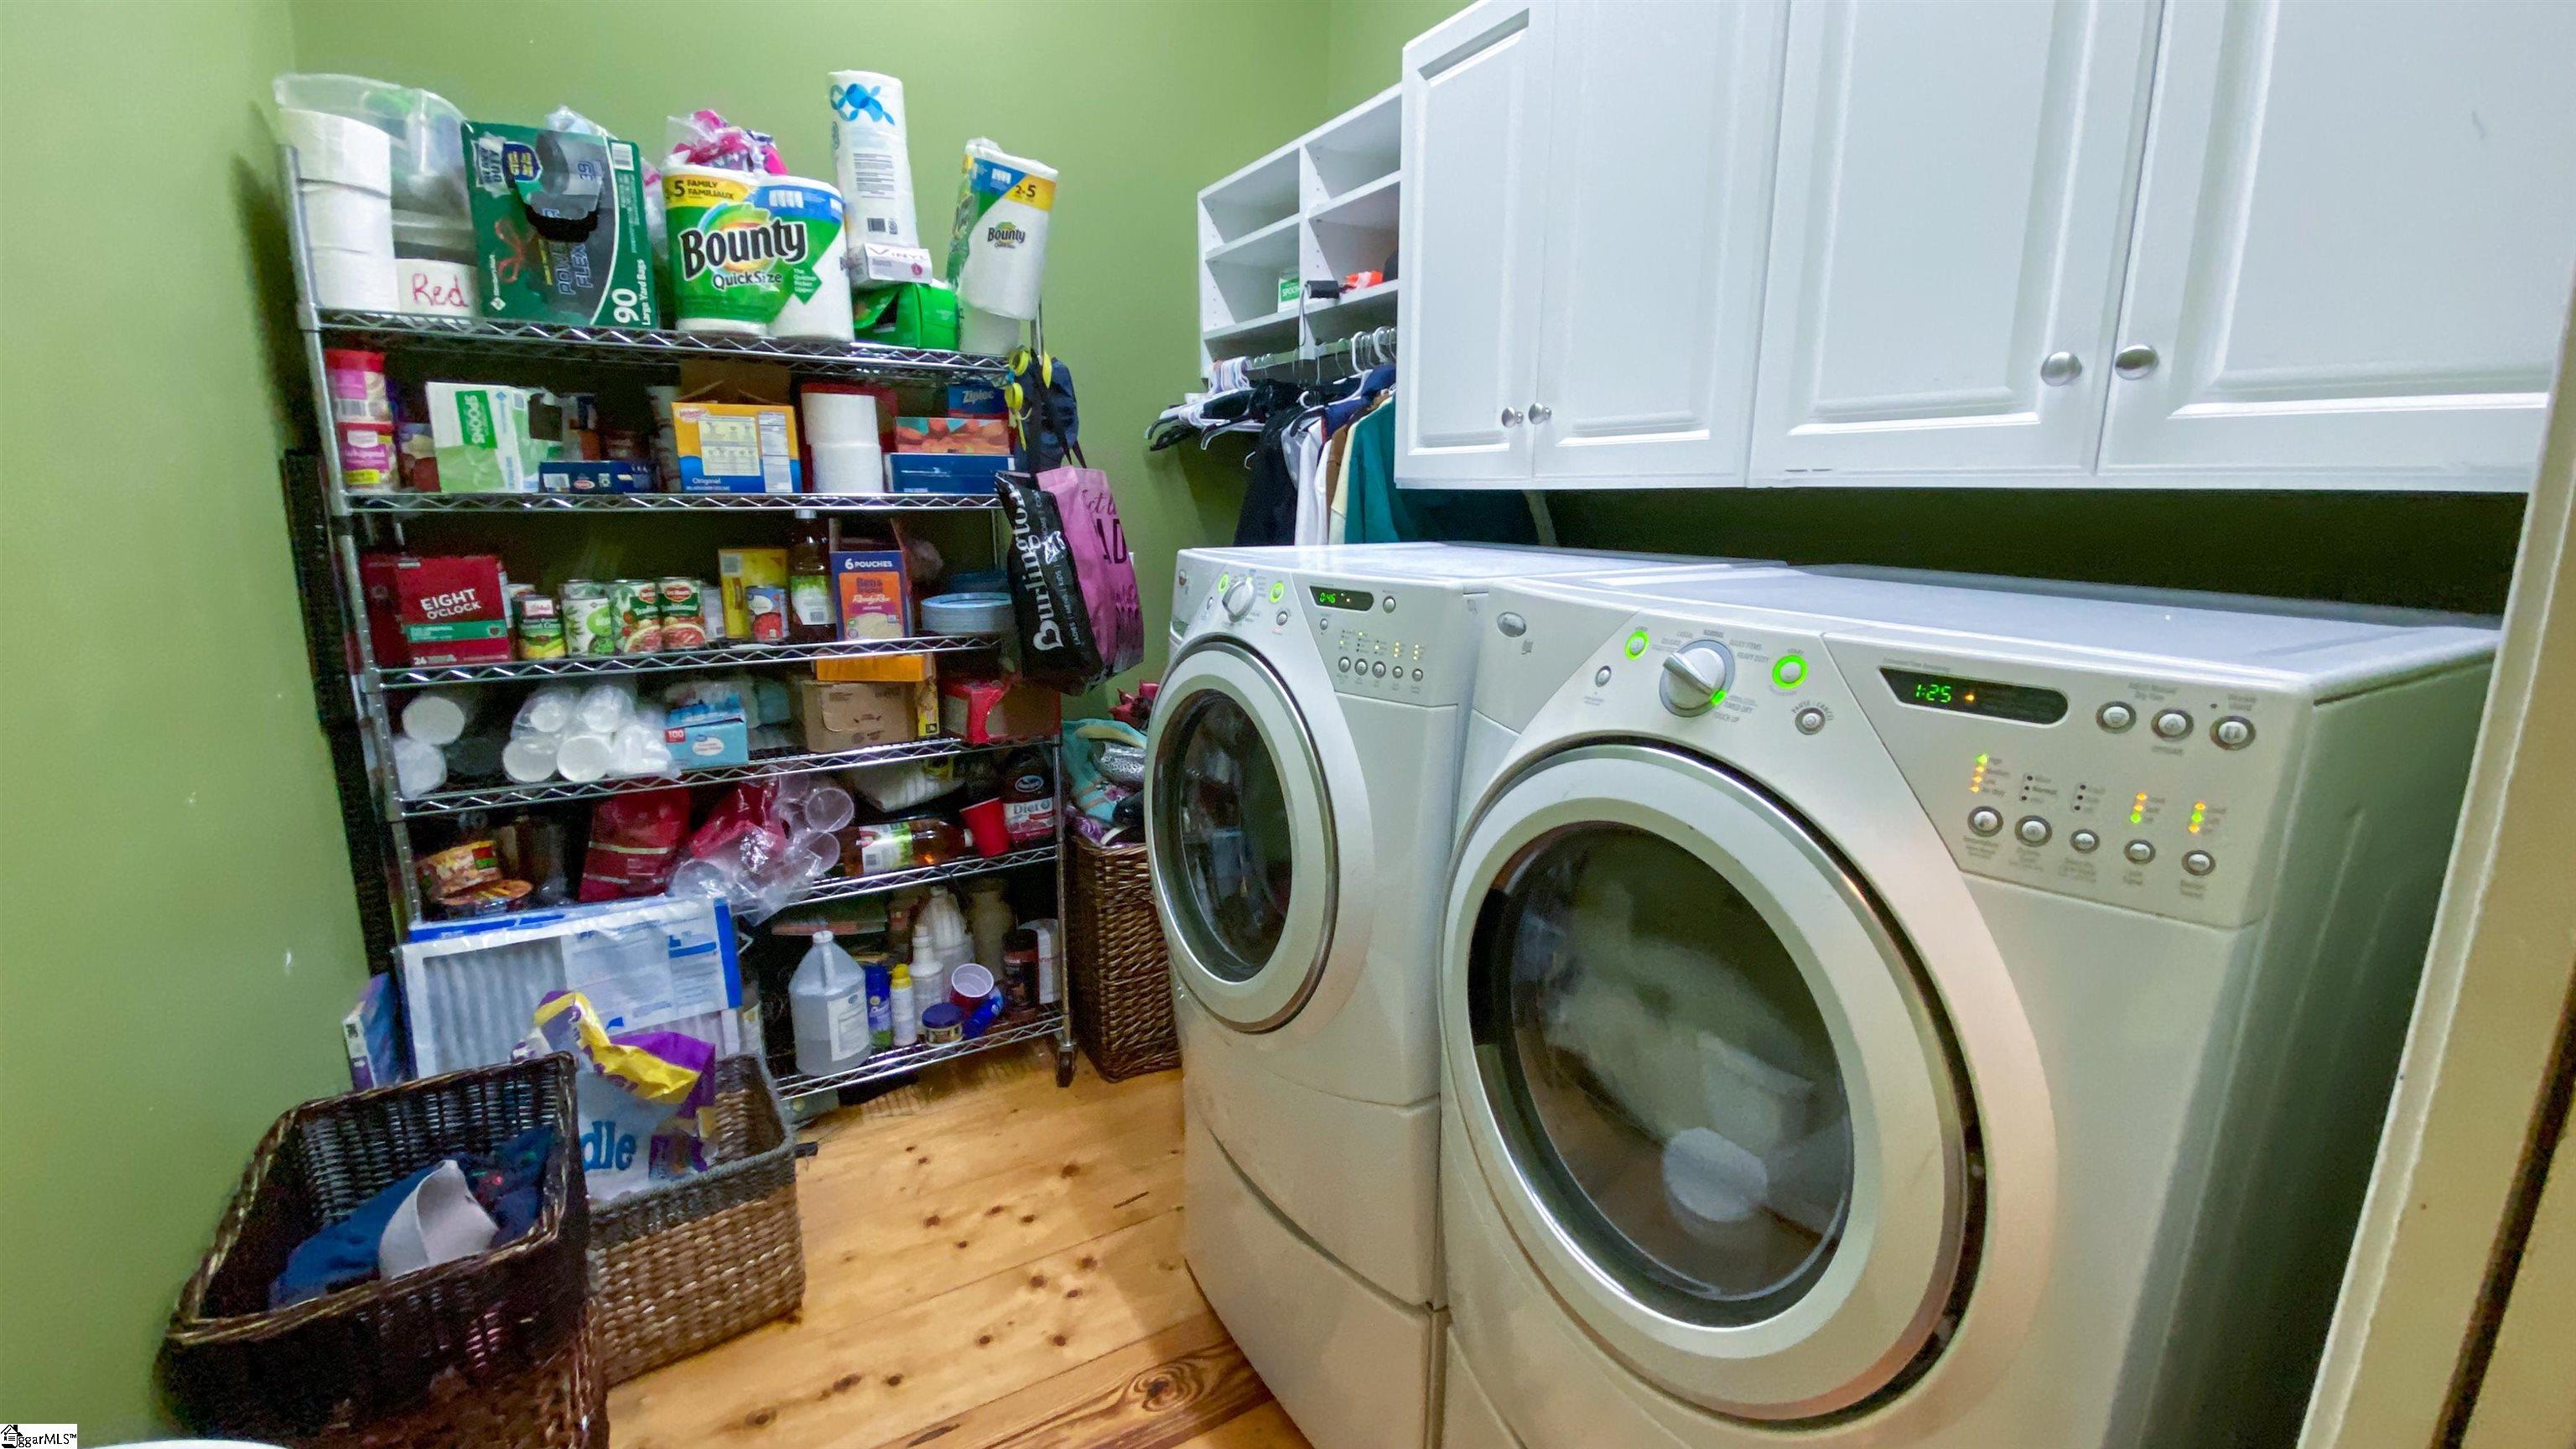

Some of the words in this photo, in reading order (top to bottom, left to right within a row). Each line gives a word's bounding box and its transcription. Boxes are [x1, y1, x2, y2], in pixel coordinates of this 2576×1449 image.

[674, 180, 685, 197] 5
[687, 179, 718, 188] FAMILY
[987, 227, 1026, 243] Bounty
[680, 216, 807, 279] Bounty
[570, 242, 593, 288] FLEX
[636, 259, 647, 280] Bags
[412, 273, 469, 308] Red
[637, 282, 648, 300] Yard
[611, 288, 640, 324] 90
[641, 302, 652, 325] Large
[962, 390, 995, 404] Ziploc
[465, 394, 486, 444] SPOONS
[692, 477, 721, 486] Original
[844, 558, 854, 570] 6
[420, 588, 475, 611] EIGHT
[426, 600, 482, 620] O'CLOCK
[1915, 683, 1951, 704] 1:25
[668, 730, 684, 739] 100
[1013, 802, 1039, 814] Diet
